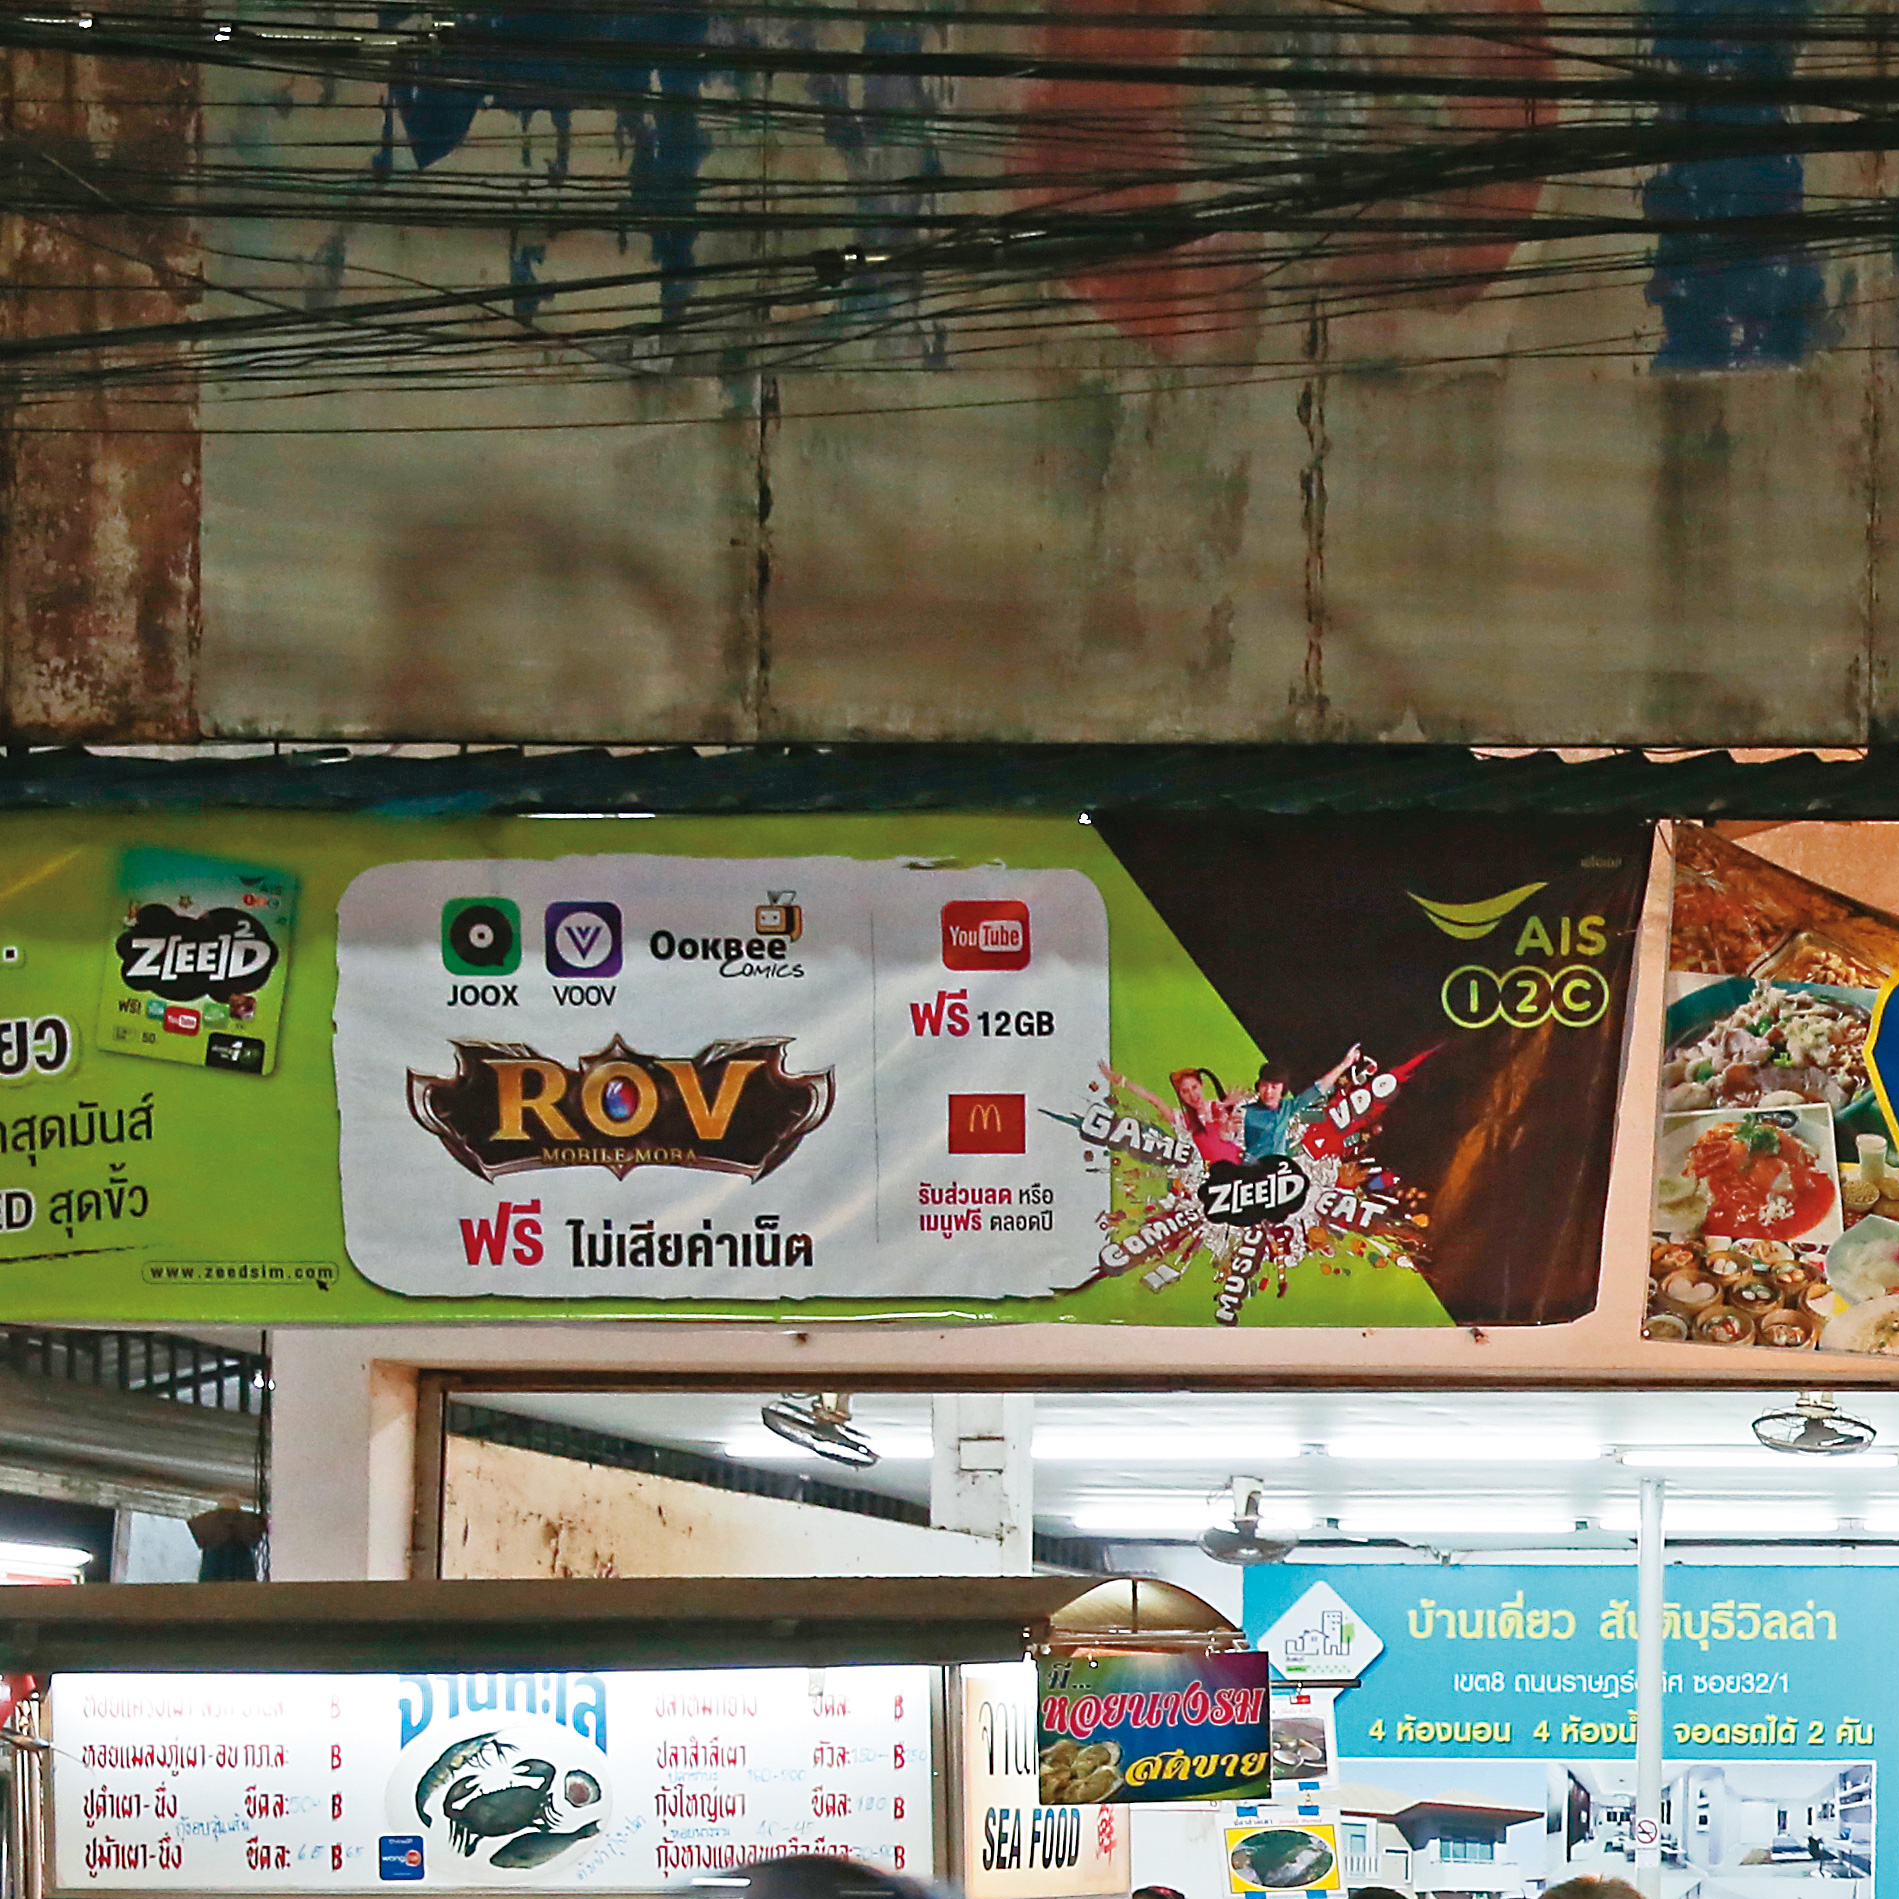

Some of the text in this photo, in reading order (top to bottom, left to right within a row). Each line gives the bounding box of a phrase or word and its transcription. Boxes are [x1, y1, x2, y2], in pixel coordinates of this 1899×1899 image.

[1515, 915, 1607, 956] AIS
[448, 985, 518, 1006] JOOX
[554, 986, 616, 1005] VOOV
[910, 988, 1055, 1037] ฟรี 12GB
[481, 1060, 766, 1140] ROV
[1328, 1071, 1398, 1130] VDO
[542, 1147, 698, 1164] MOBILE MOBA
[1081, 1103, 1194, 1165] GAME
[919, 1181, 1053, 1206] รับส่วนลด หรือ
[1316, 1190, 1388, 1228] EAT
[460, 1199, 813, 1268] ฟรี ไม่เสียค่าเน็ต
[919, 1207, 1053, 1239] เมนูฟรี ตลอดปี
[1100, 1209, 1199, 1268] COMICS
[150, 1265, 334, 1279] www.zeedsim.com
[1214, 1228, 1264, 1322] MUSIC
[1407, 1591, 1576, 1640] บ้านเดี่ยว
[1693, 1671, 1790, 1694] ซอย32/1
[1042, 1680, 1266, 1739] หอยนางรม
[1370, 1715, 1874, 1745] 4 ห้องนอน 4 จอดรถได้ 2 คัน
[982, 1807, 1021, 1871] SEA
[1029, 1806, 1081, 1869] FOOD
